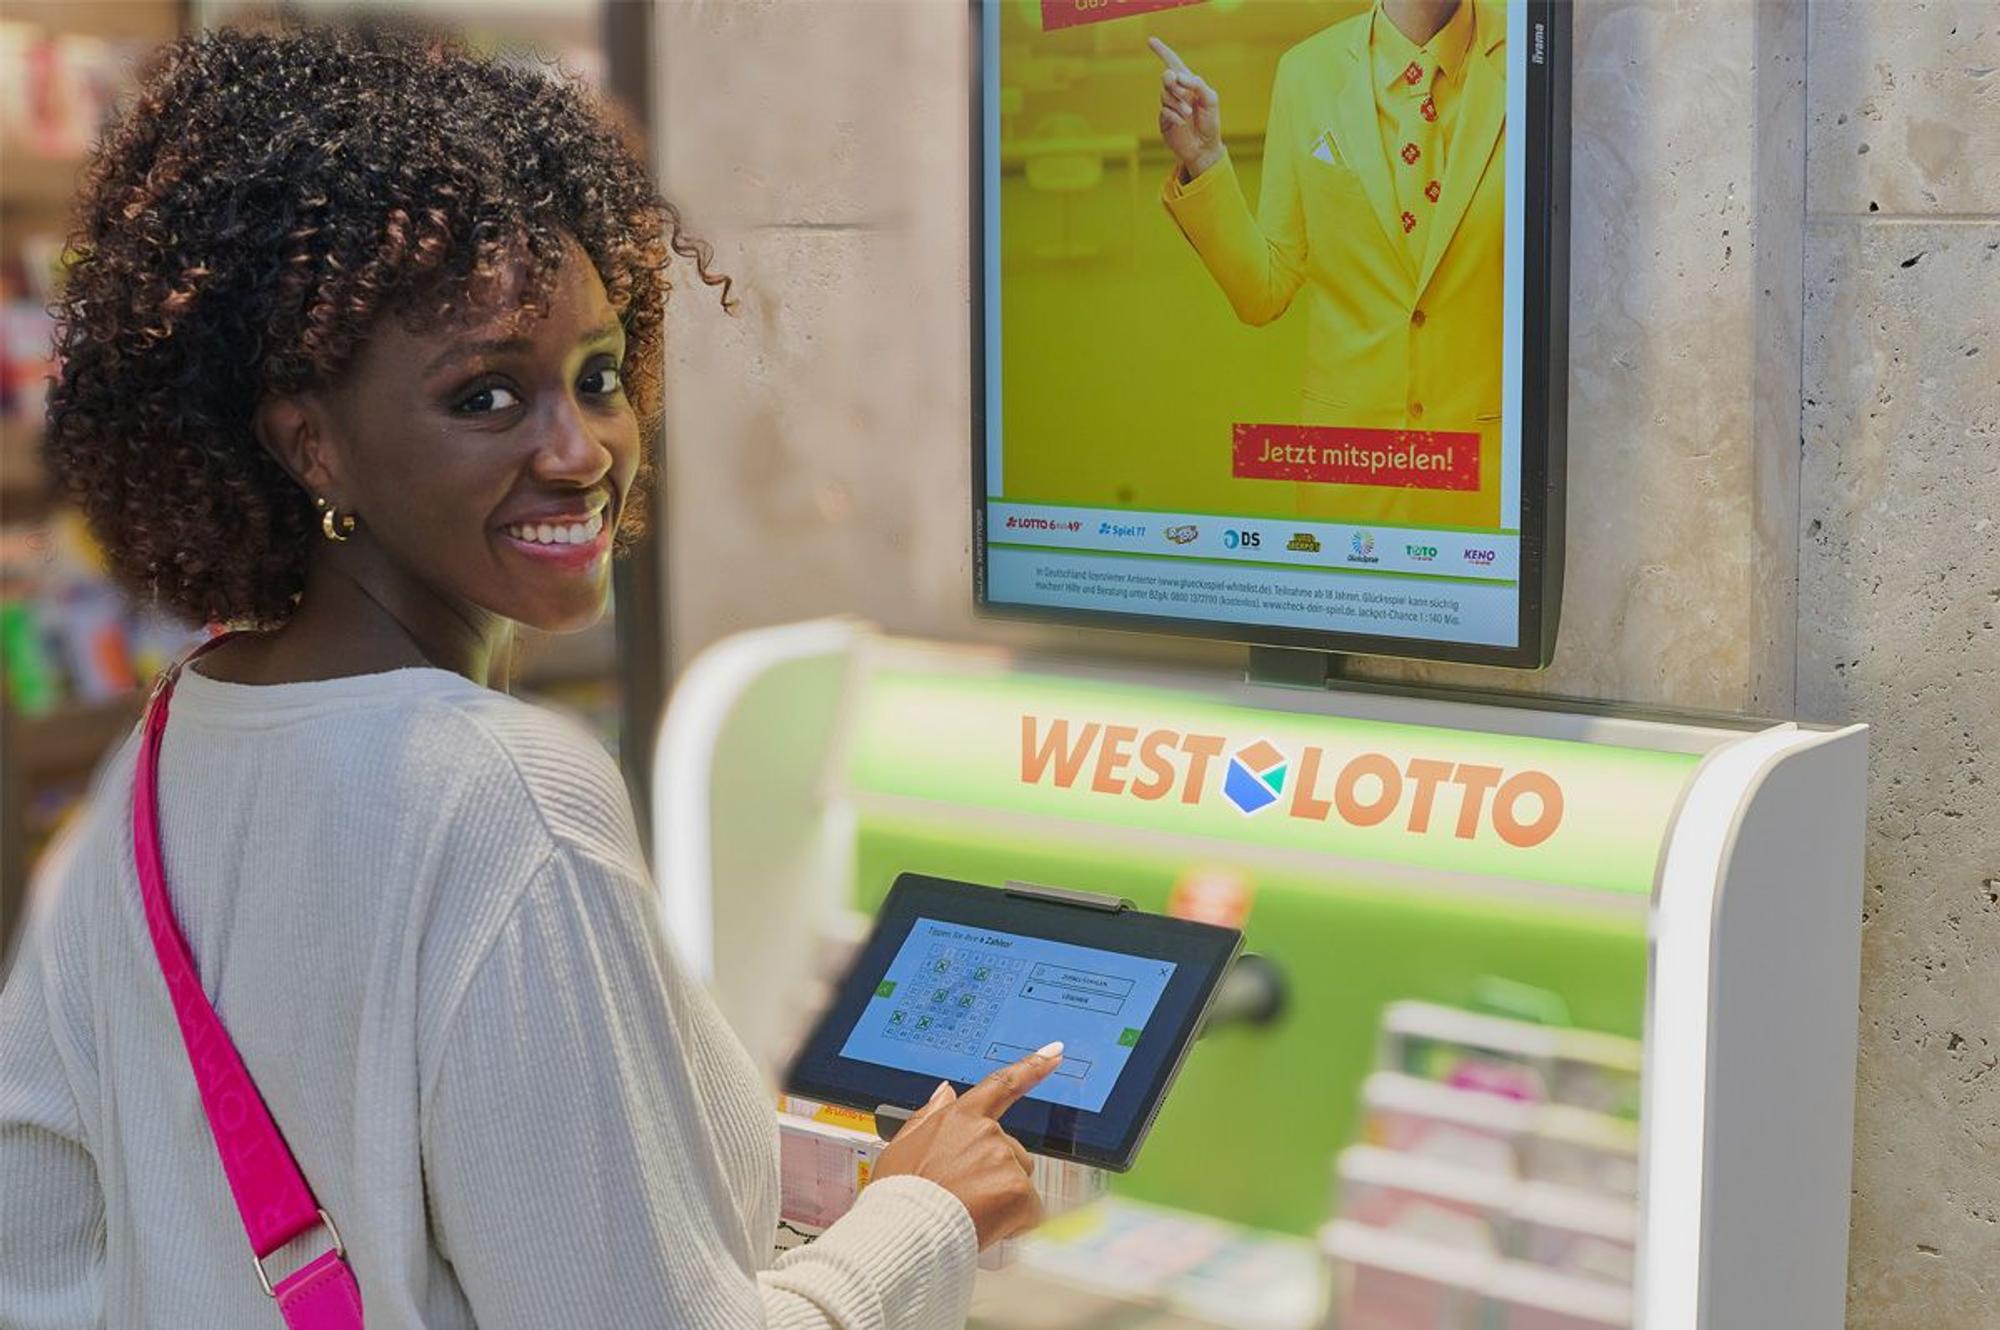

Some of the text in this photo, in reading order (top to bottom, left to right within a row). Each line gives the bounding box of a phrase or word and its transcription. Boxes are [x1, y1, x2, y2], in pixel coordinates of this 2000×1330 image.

[1259, 438, 1454, 474] Jetzt mitspielen!
[1018, 517, 1048, 530] LOTTO
[1112, 524, 1135, 537] Spiel
[1241, 530, 1261, 547] DS
[1406, 544, 1438, 558] TOTO
[1463, 548, 1496, 562] KENO
[1020, 715, 1565, 848] WEST LOTTO
